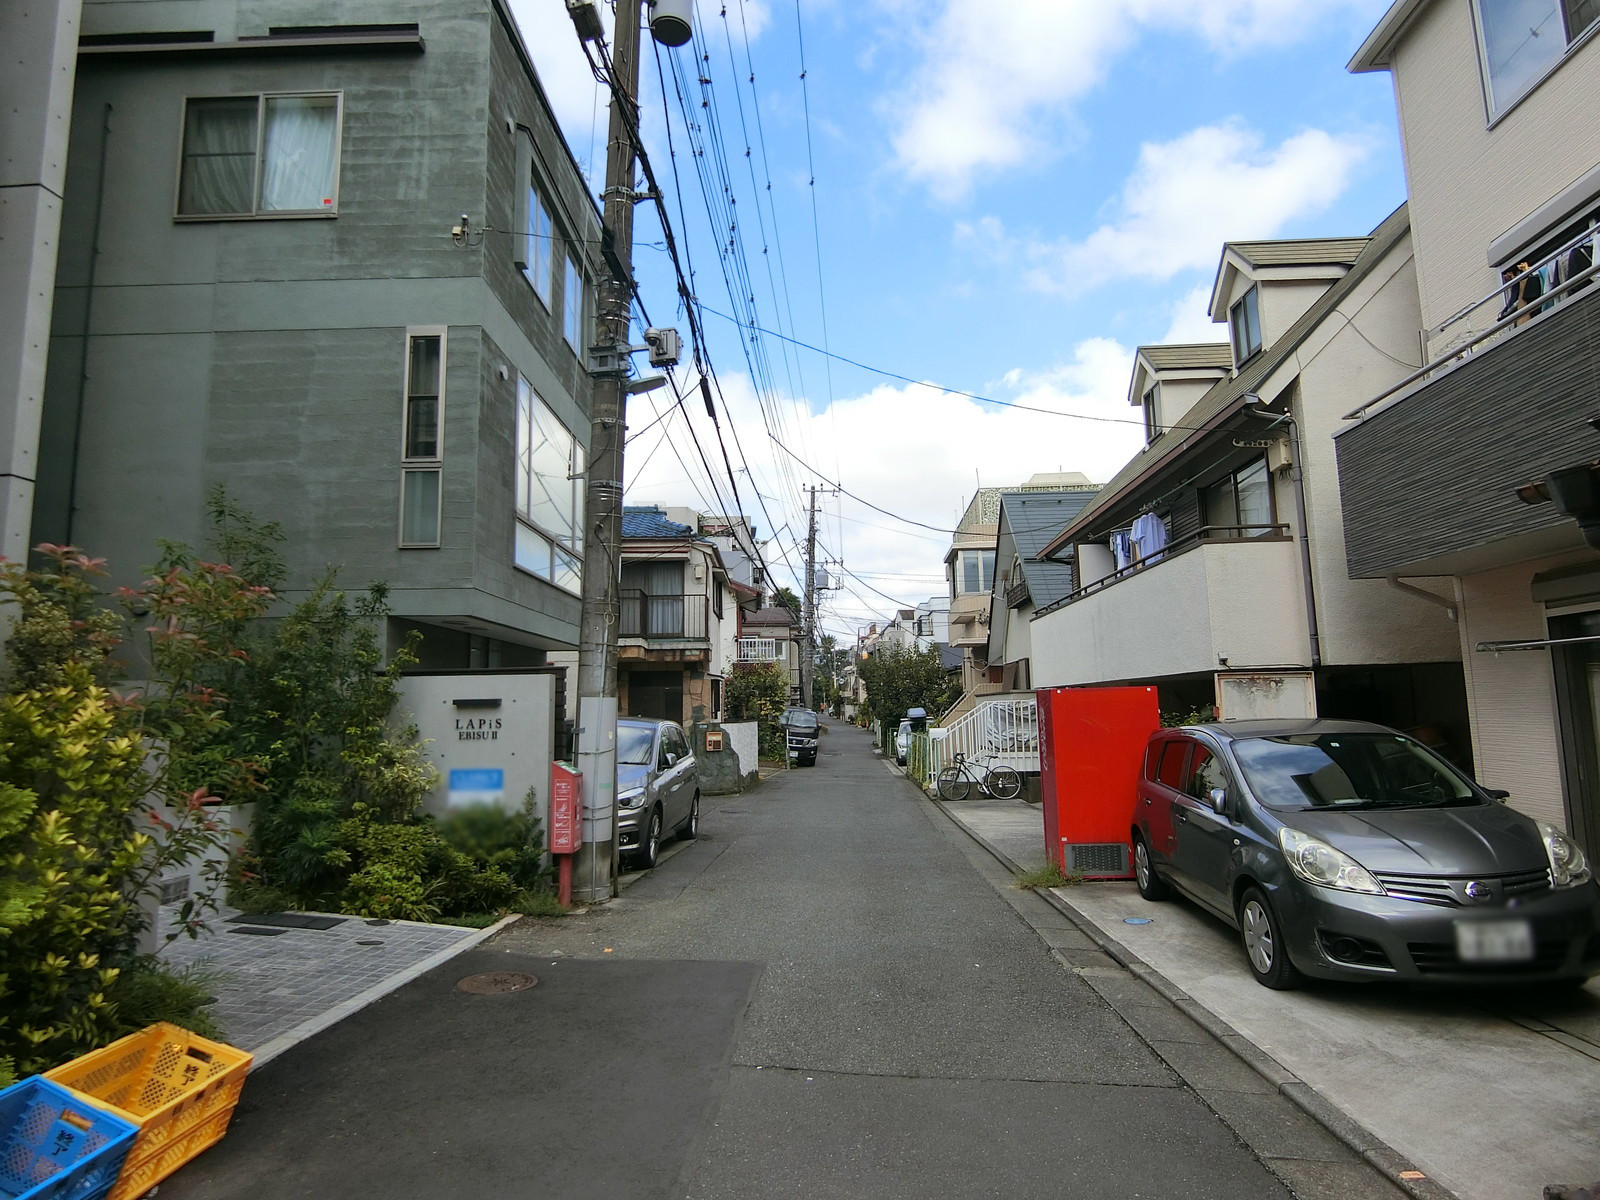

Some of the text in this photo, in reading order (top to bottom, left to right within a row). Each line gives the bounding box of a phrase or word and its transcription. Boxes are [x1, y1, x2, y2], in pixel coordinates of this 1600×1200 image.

[455, 718, 502, 729] LAPiS
[459, 731, 498, 740] EBISU II
[182, 1064, 200, 1086] 終了
[51, 1129, 75, 1156] 終了
